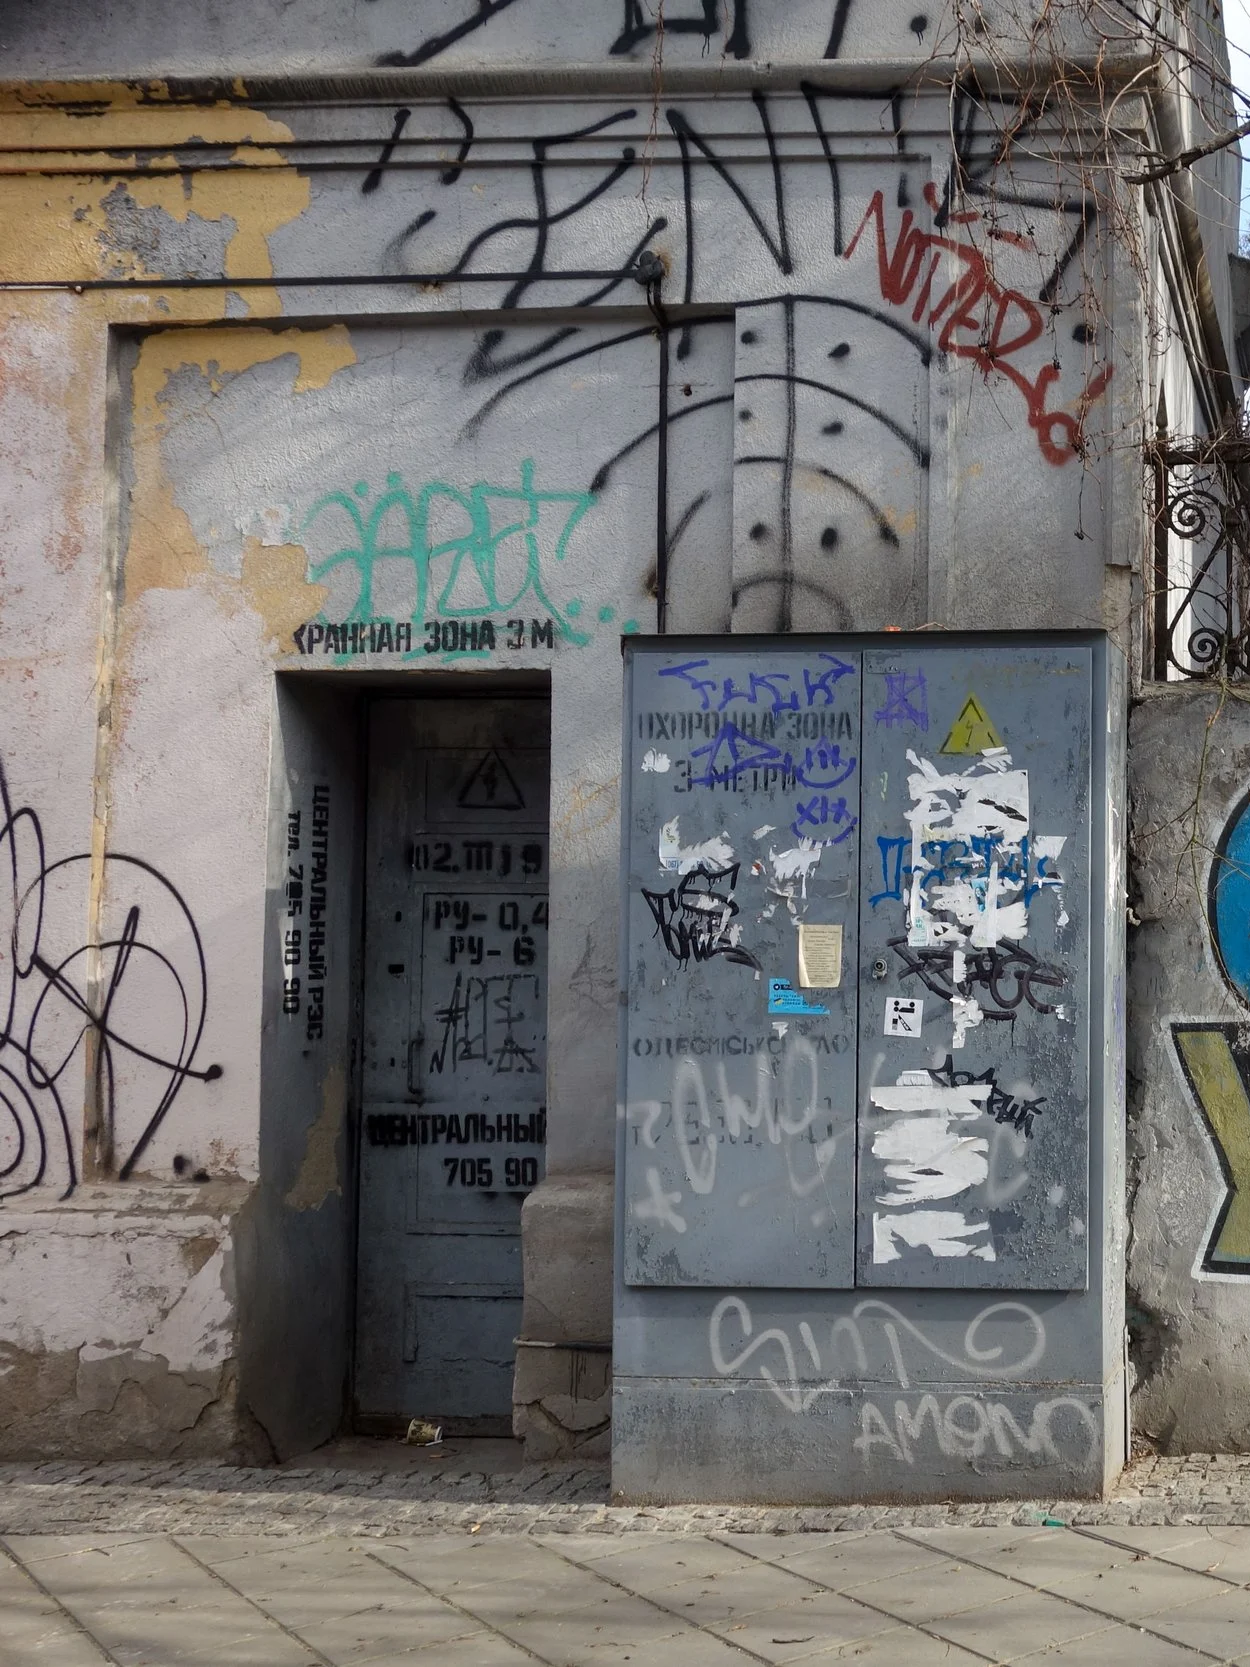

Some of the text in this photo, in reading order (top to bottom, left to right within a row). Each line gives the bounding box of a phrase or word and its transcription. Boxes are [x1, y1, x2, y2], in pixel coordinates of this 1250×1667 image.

[424, 620, 496, 653] ЗОНА
[532, 617, 554, 649] М
[787, 711, 853, 740] ЗОНА
[307, 785, 330, 982] ЦЕНТРАЛЬНЫЙ
[284, 930, 301, 965] 90
[283, 978, 301, 1015] 90
[444, 1157, 538, 1187] 705 90
